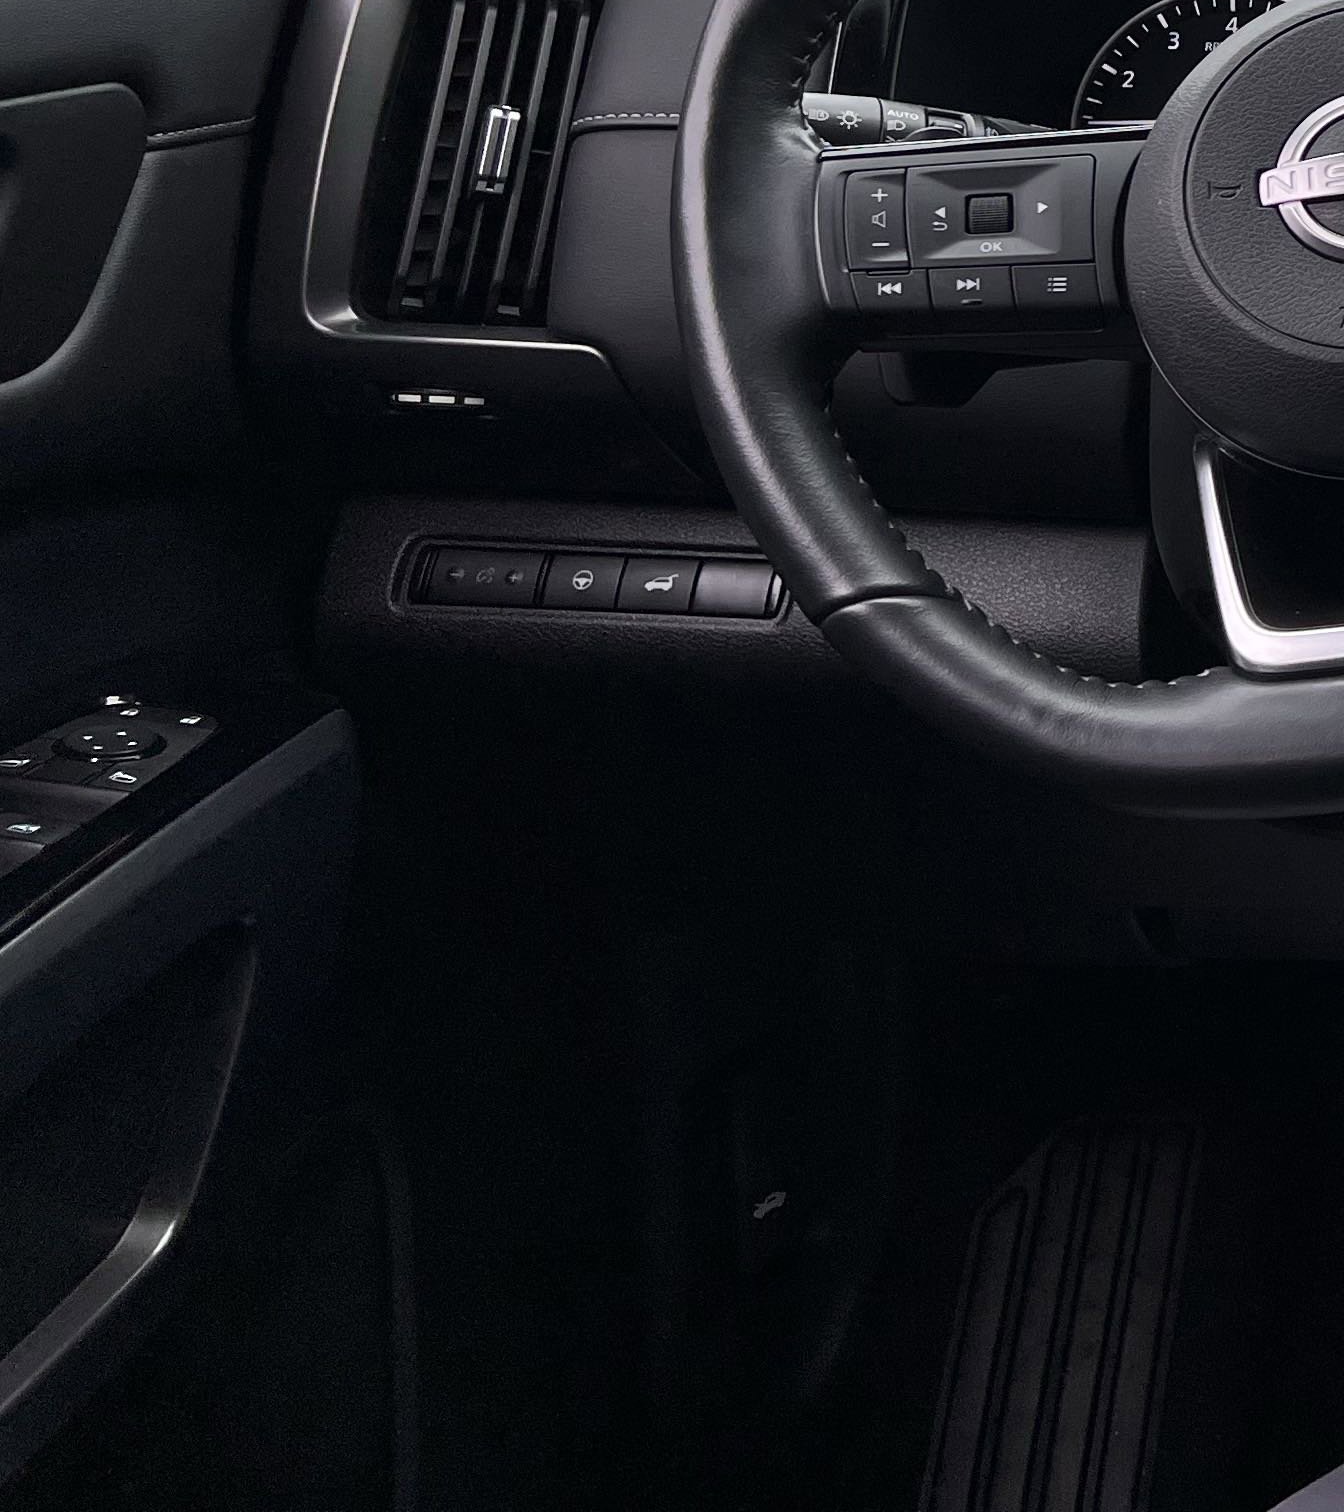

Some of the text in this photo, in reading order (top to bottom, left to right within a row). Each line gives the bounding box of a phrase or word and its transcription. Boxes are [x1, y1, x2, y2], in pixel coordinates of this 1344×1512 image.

[1225, 16, 1239, 33] 4
[1167, 31, 1180, 50] 3
[1121, 71, 1135, 88] 2
[887, 109, 919, 121] AUTO
[979, 241, 1003, 253] OK
